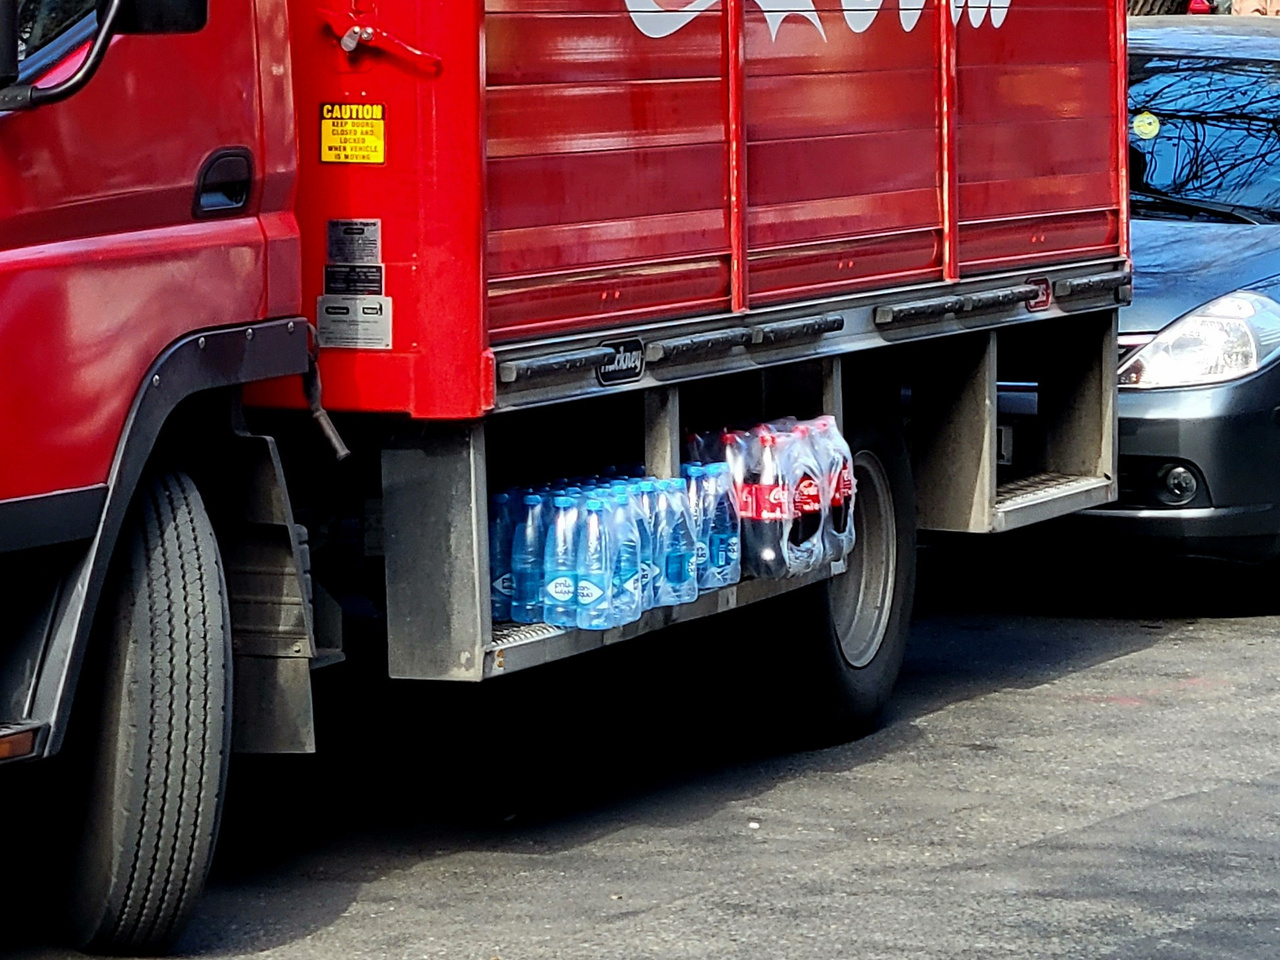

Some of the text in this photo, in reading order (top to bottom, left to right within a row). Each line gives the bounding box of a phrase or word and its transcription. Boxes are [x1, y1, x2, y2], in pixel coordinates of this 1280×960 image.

[323, 104, 383, 119] CAUTION
[350, 145, 379, 153] VEHICLE
[344, 153, 371, 161] MOVING
